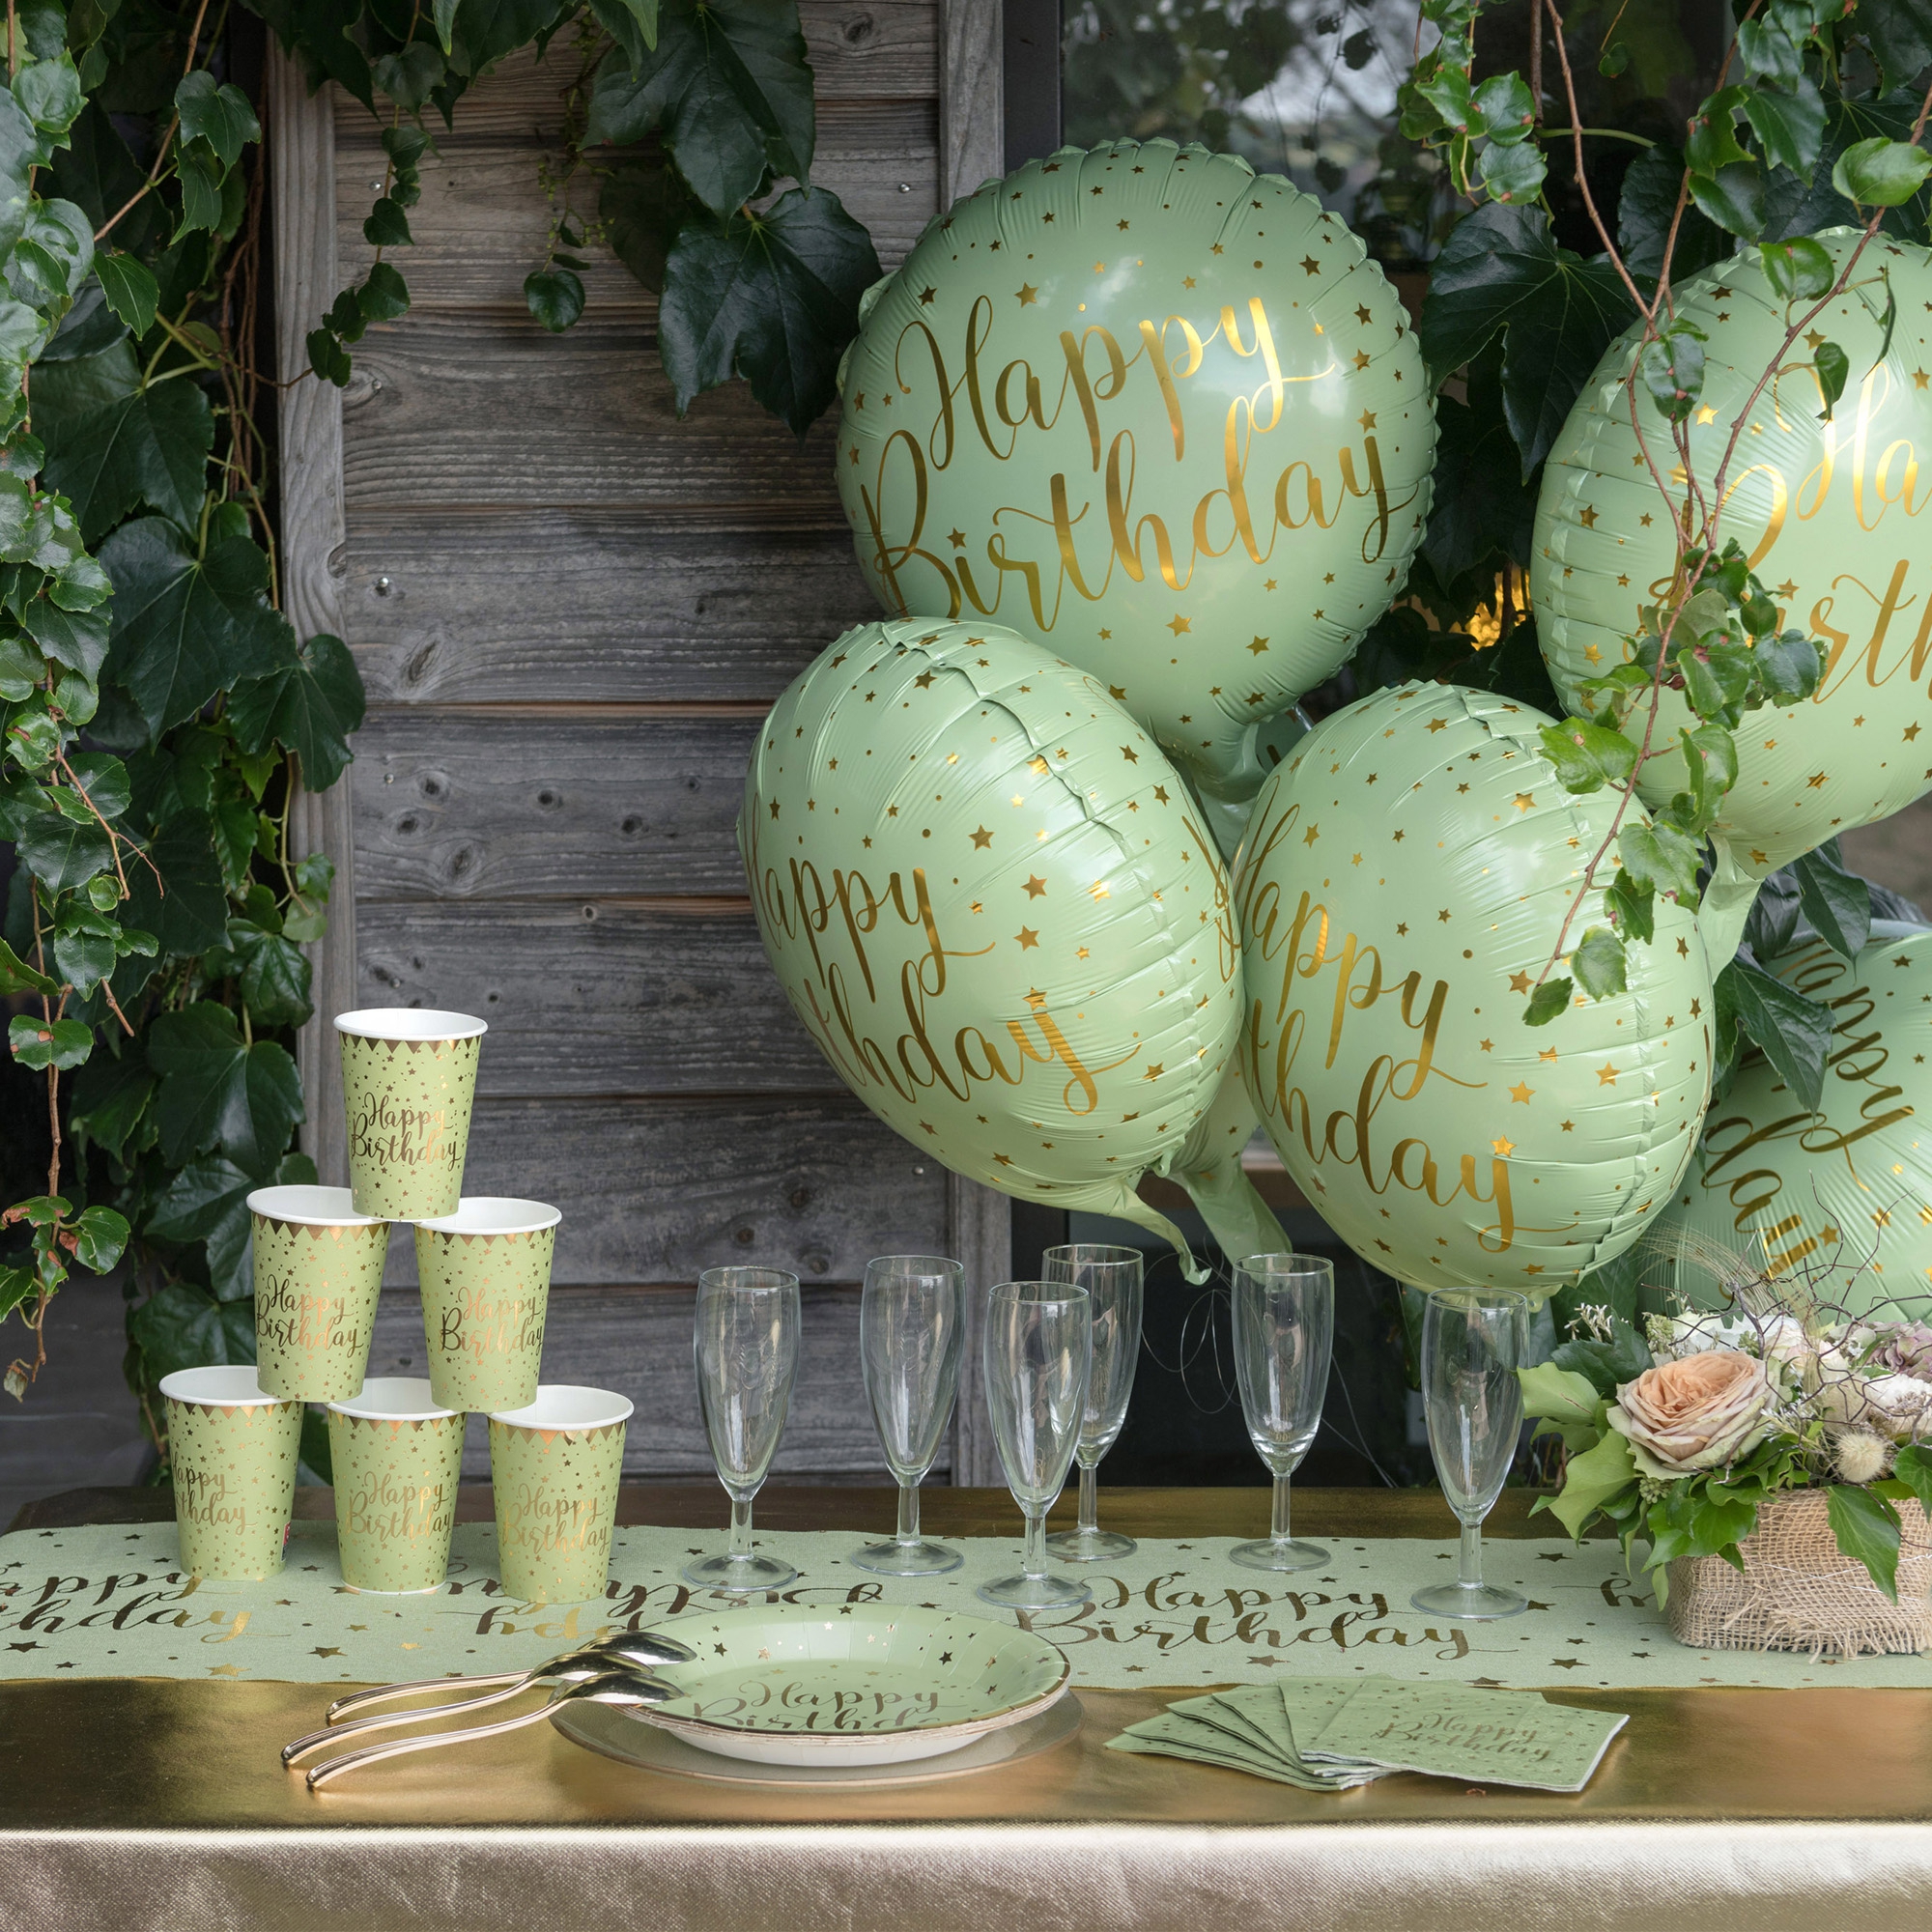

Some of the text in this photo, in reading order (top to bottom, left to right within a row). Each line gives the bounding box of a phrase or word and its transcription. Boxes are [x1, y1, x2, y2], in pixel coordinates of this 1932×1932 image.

[895, 296, 1336, 473] Happy
[861, 396, 1420, 633] Birthday
[364, 1092, 454, 1141] Happy
[351, 1112, 463, 1172] Birthday
[267, 1273, 355, 1326] Happy
[458, 1286, 541, 1330] Happy
[256, 1293, 364, 1358] Birthday
[439, 1307, 542, 1358] Birthday
[346, 1491, 451, 1543] Birthday
[363, 1470, 449, 1515] Happy
[518, 1482, 605, 1528] Happy
[502, 1500, 610, 1555] Birthday
[0, 1569, 242, 1606] appy
[1079, 1575, 1429, 1621] Happy
[1012, 1600, 1520, 1660] Birthday
[738, 1679, 968, 1715] Happy
[1370, 1721, 1551, 1763] Birthday
[1422, 1713, 1548, 1745] Happy
